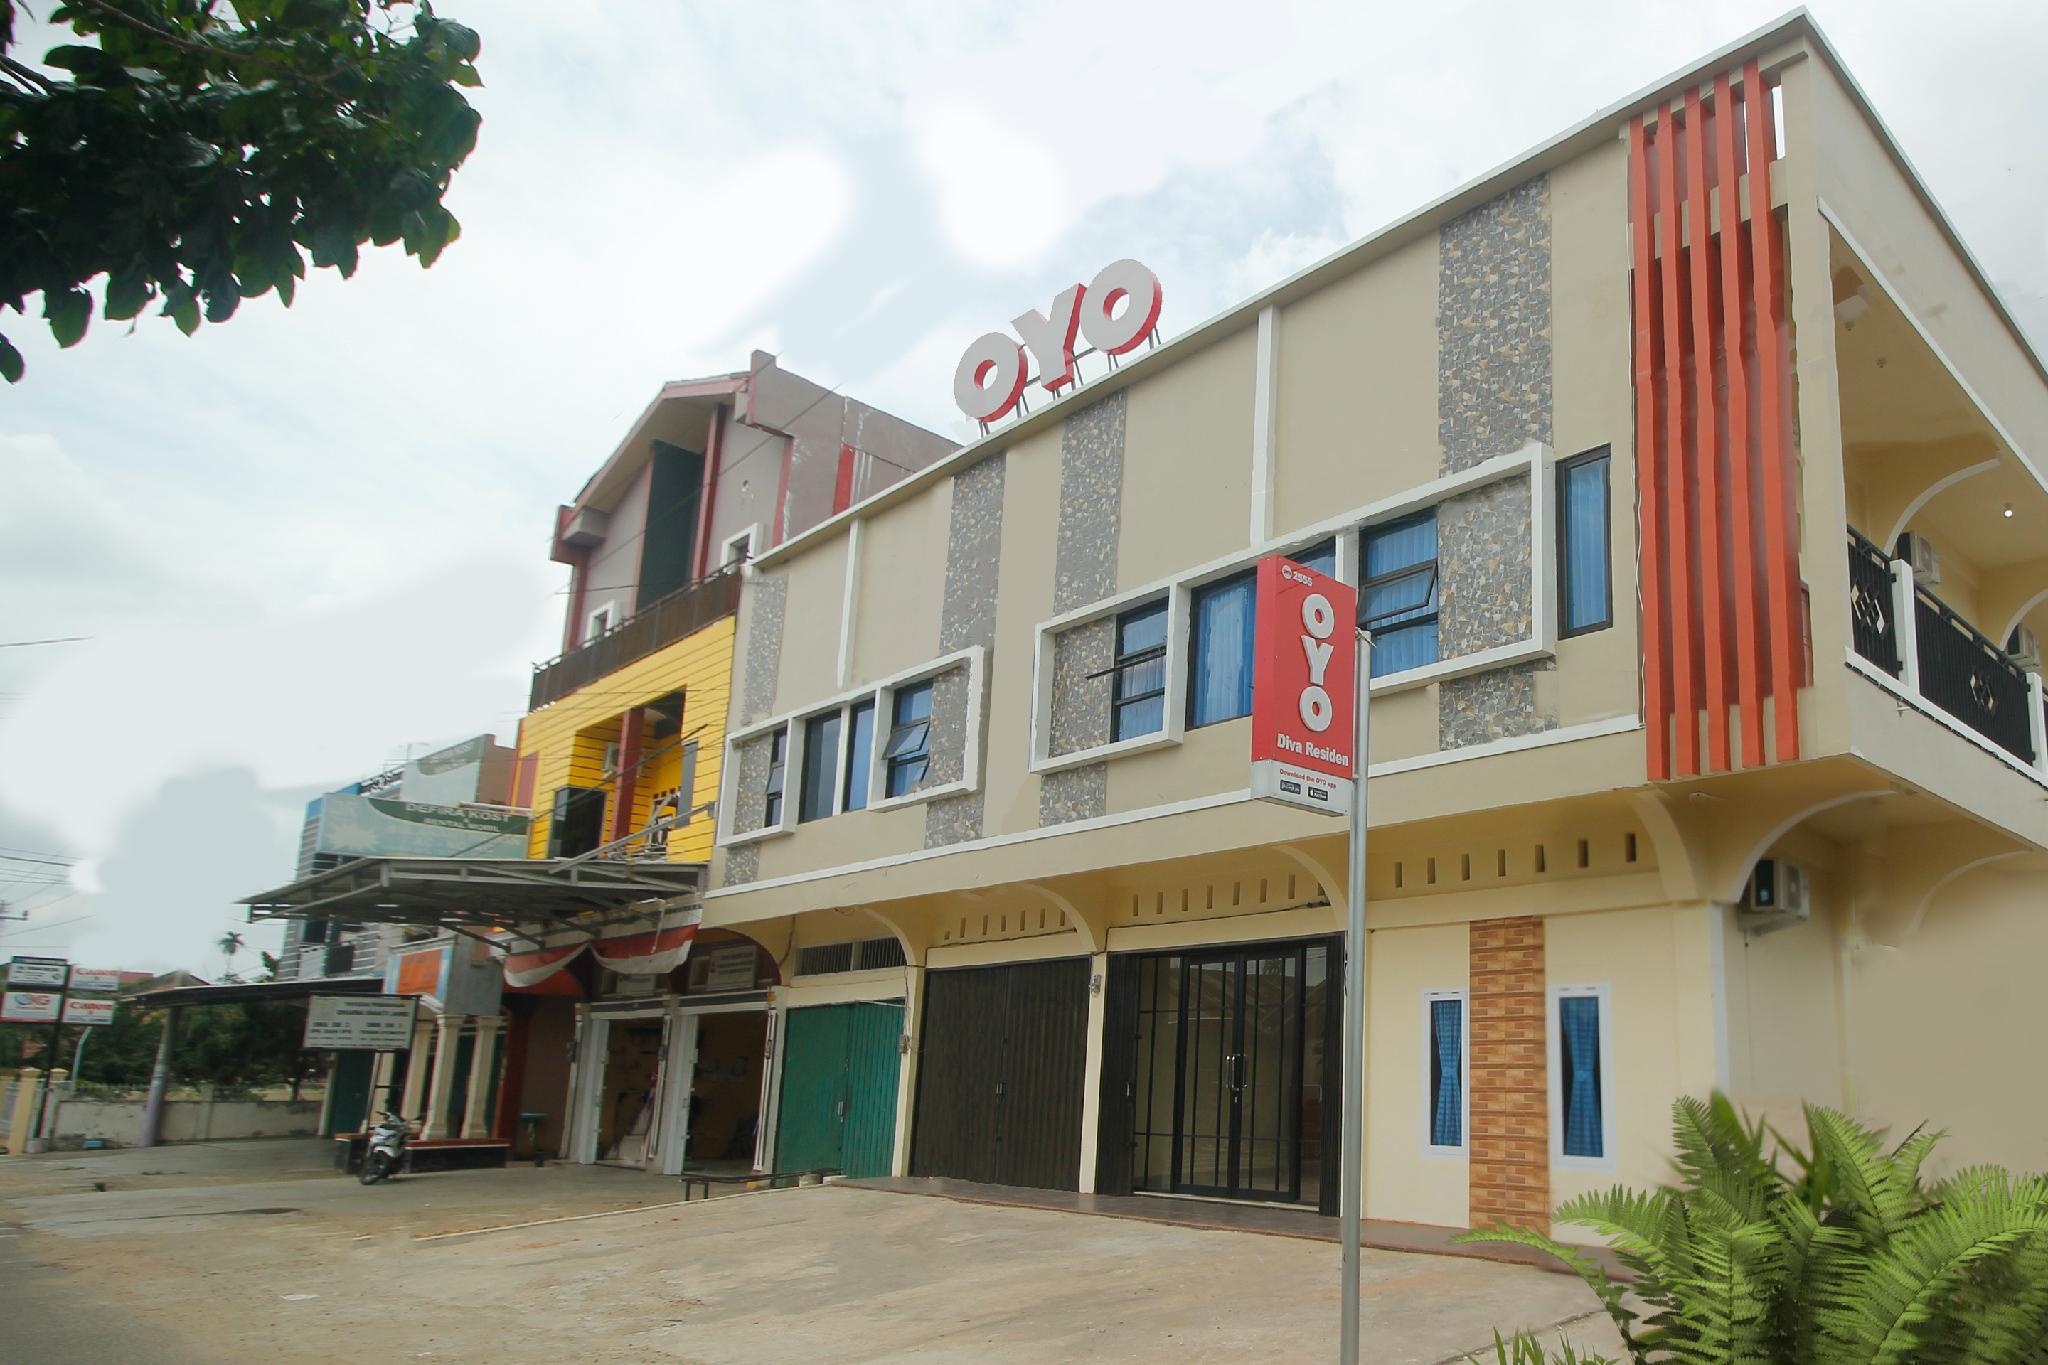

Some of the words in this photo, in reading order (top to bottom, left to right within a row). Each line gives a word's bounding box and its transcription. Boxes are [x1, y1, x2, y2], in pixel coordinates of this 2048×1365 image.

[954, 258, 1162, 423] OYO
[1300, 593, 1335, 732] OYO
[1277, 733, 1303, 753] Diva
[1305, 742, 1349, 766] Residen
[405, 802, 465, 817] DEFIRA
[468, 809, 512, 823] KOST
